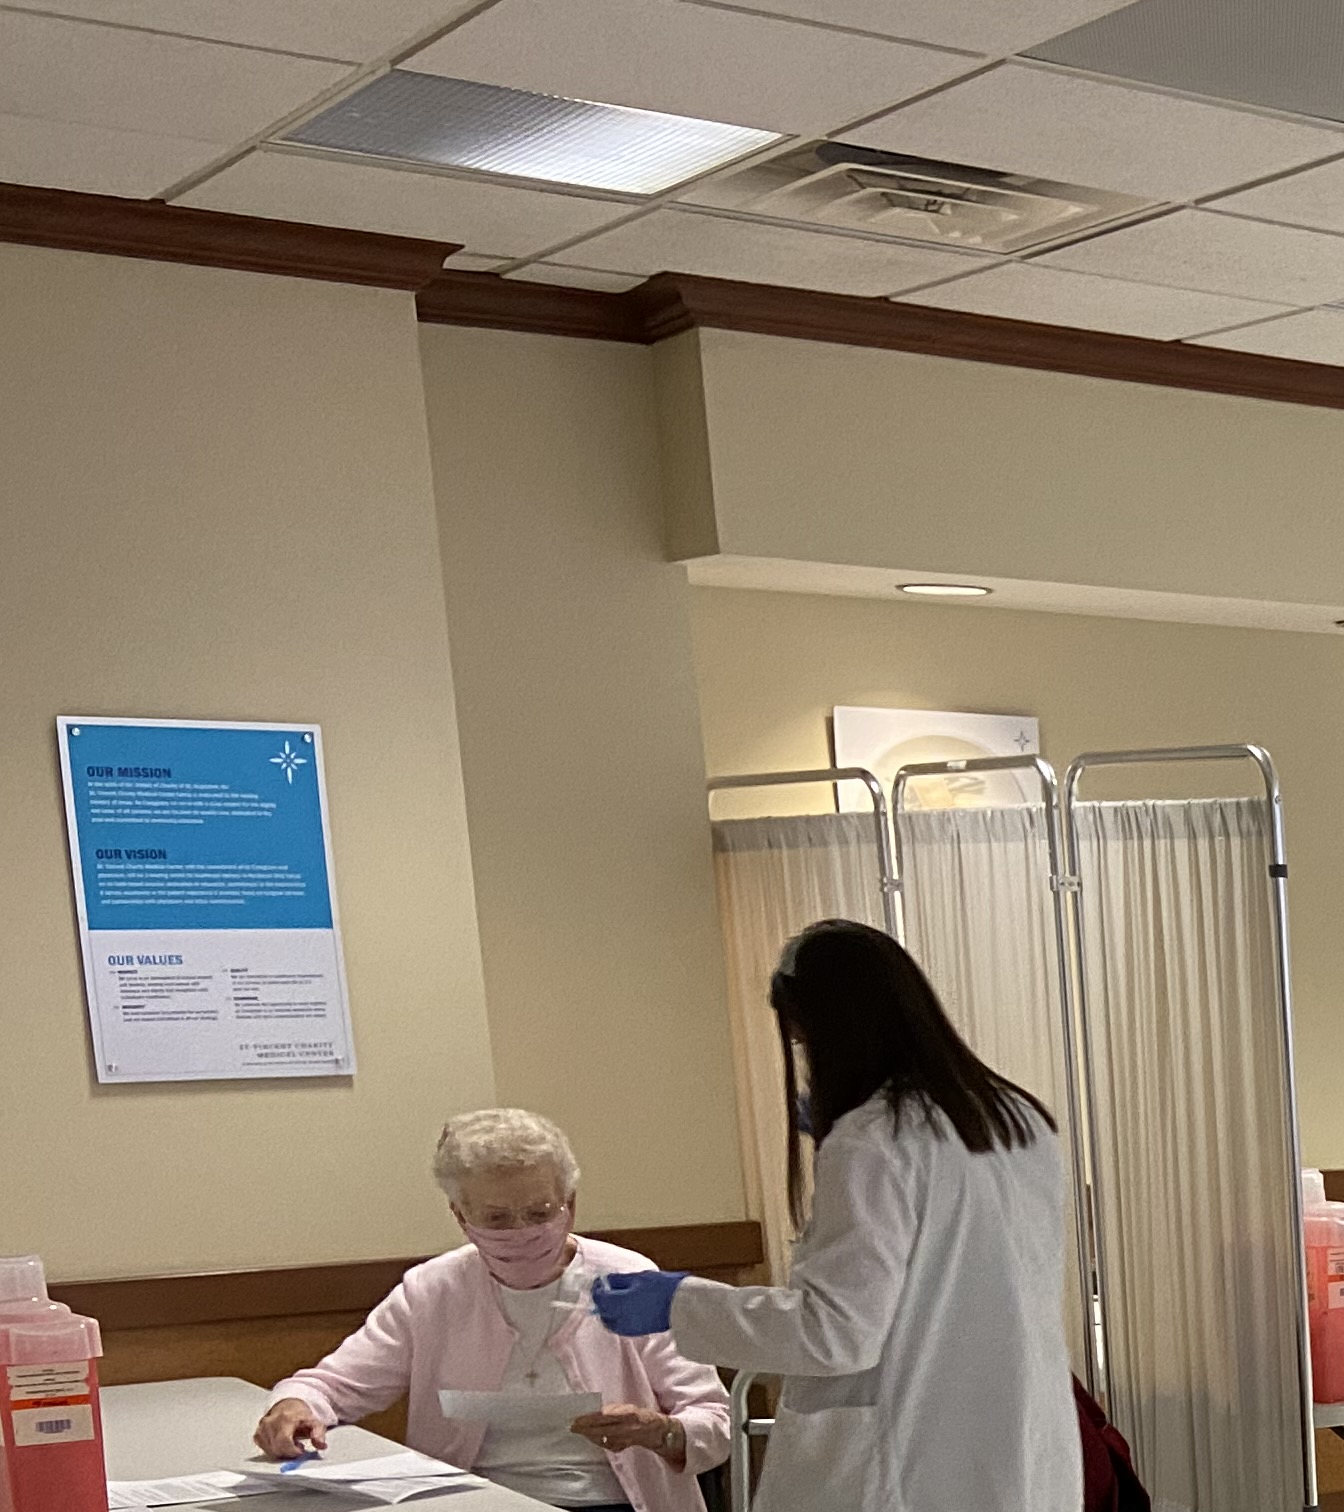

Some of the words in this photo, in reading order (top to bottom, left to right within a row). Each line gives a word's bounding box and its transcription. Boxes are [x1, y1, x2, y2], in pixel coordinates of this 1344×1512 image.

[87, 766, 113, 778] OUR
[117, 766, 171, 779] MISSION
[96, 849, 122, 860] OUR
[125, 849, 167, 860] VISION
[108, 955, 134, 966] OUR
[137, 955, 183, 966] VALUES
